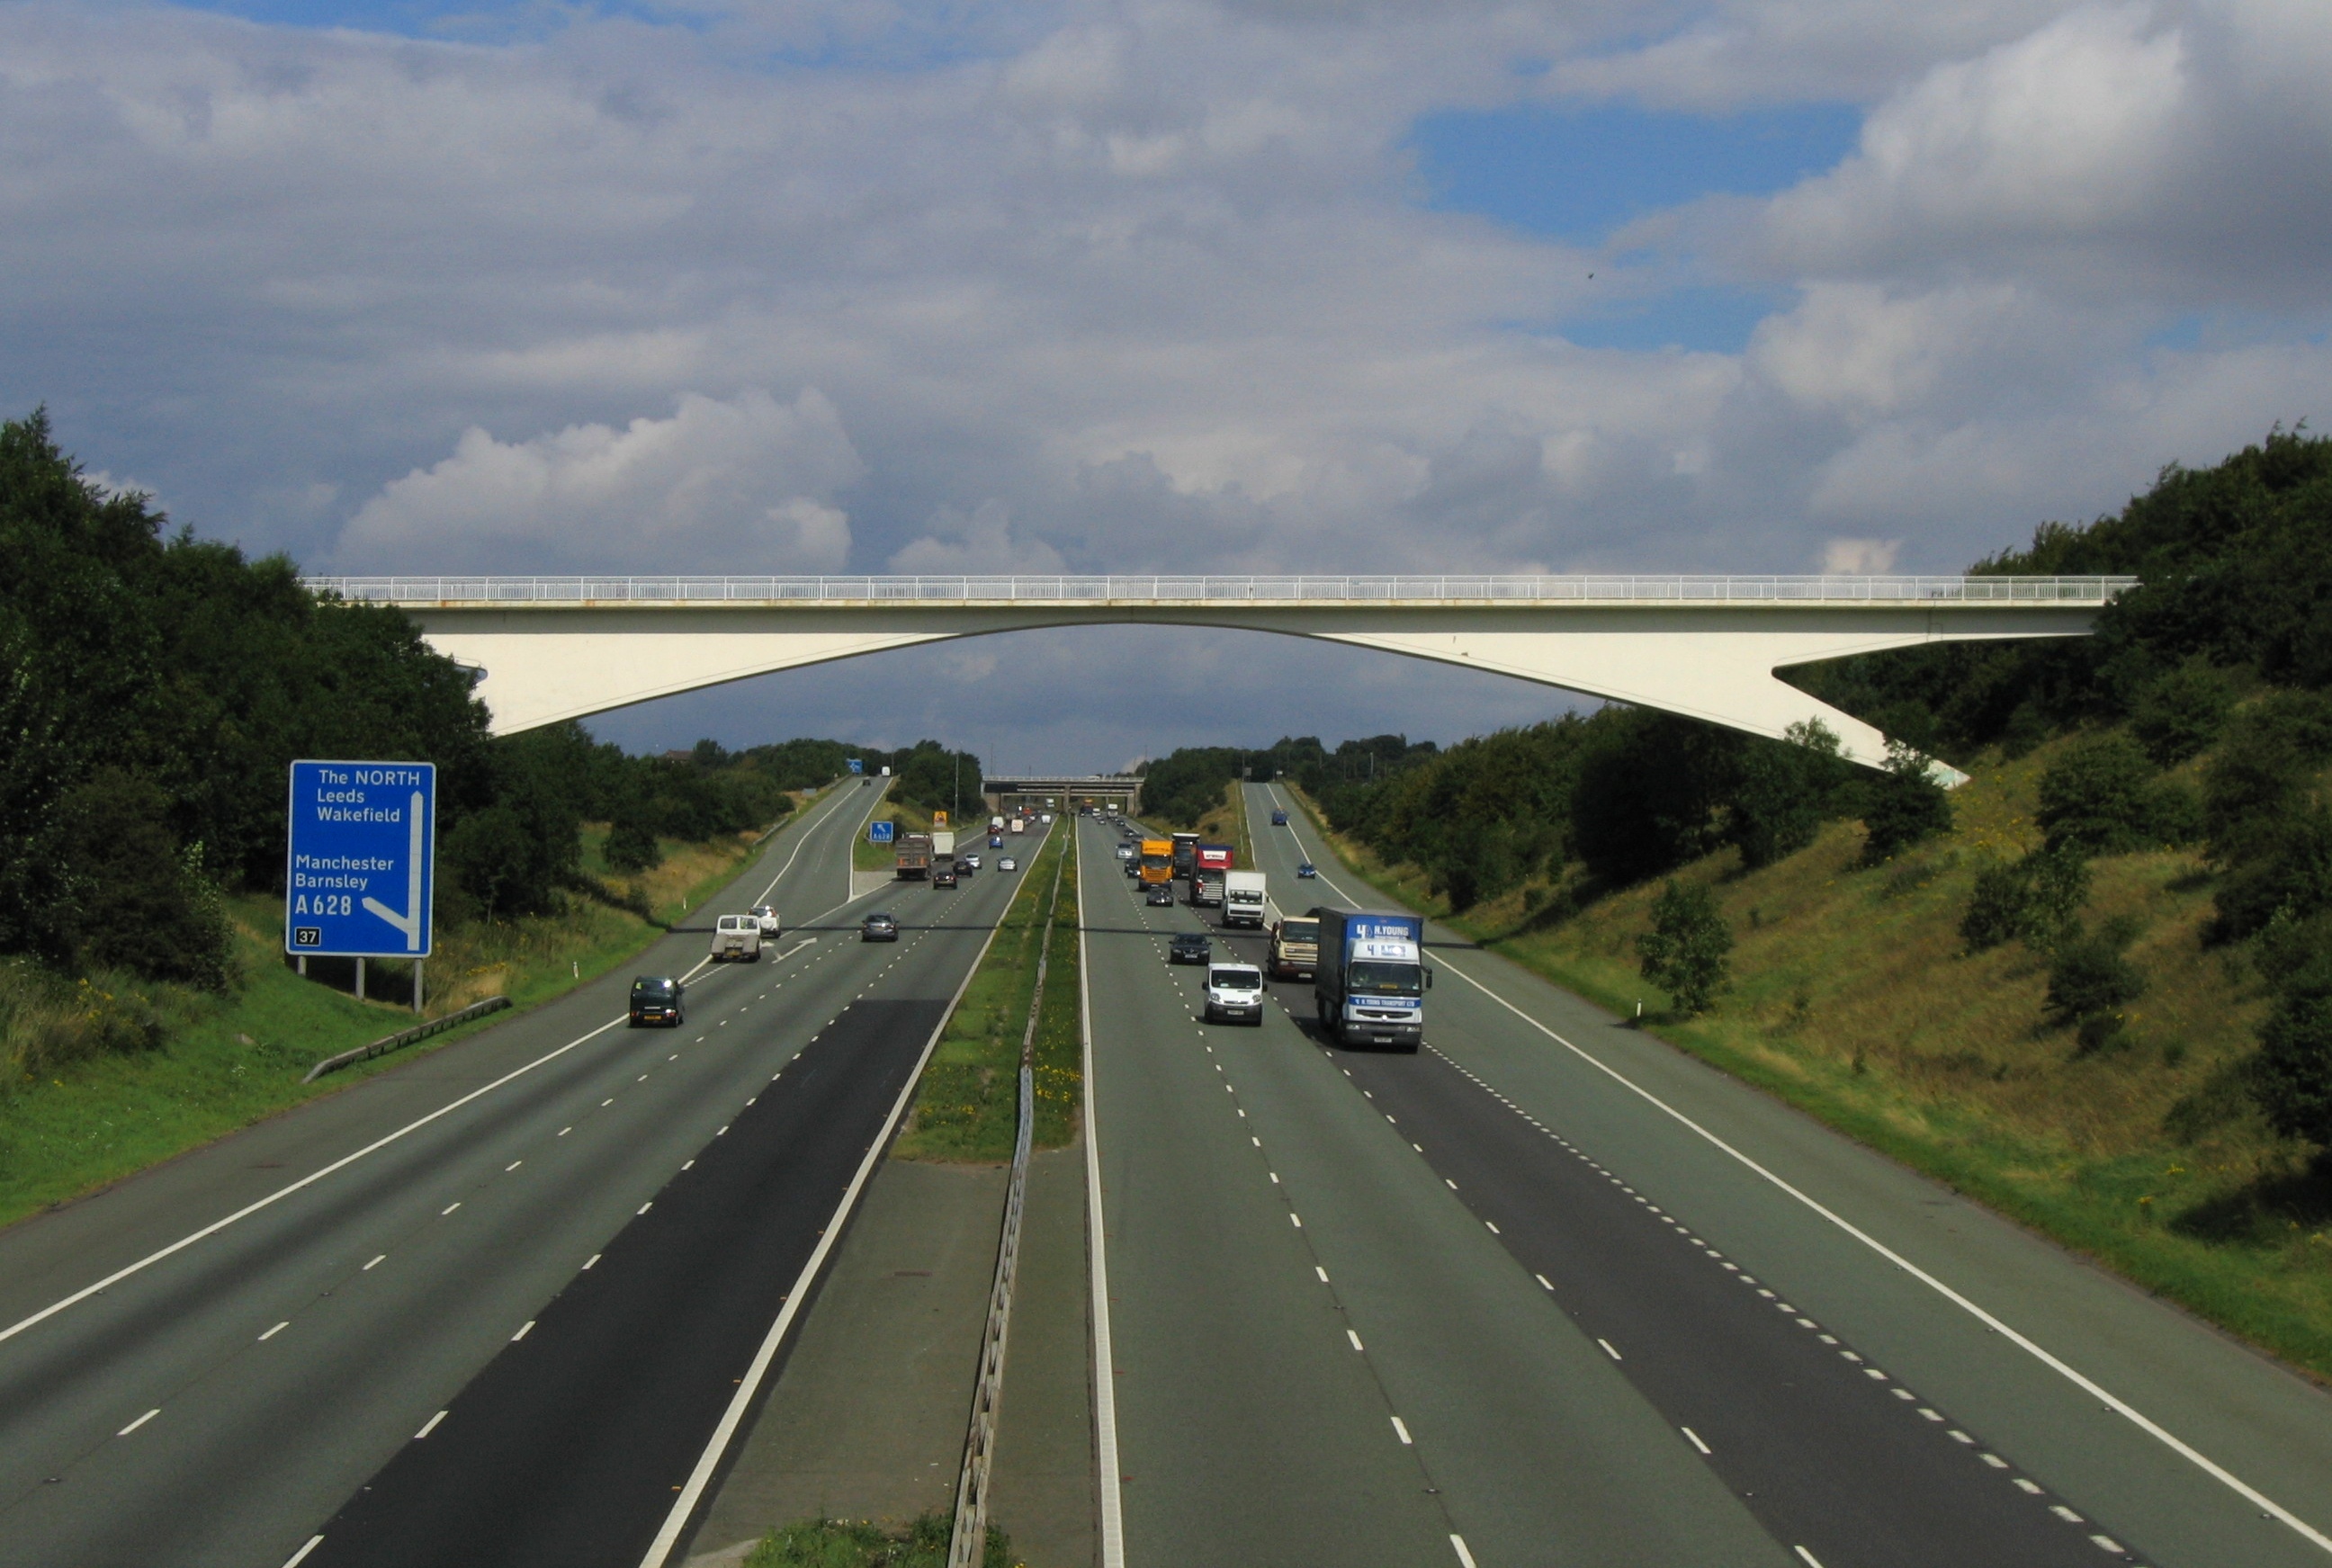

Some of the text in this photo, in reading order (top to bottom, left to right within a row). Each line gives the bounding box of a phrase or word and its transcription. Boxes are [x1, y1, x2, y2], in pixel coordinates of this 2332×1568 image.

[318, 769, 420, 785] The NORTH
[317, 788, 365, 803] Leeds
[317, 806, 400, 822] Wakefield
[295, 855, 394, 871] Manchester
[295, 873, 368, 891] Barnsley
[299, 931, 317, 943] 37
